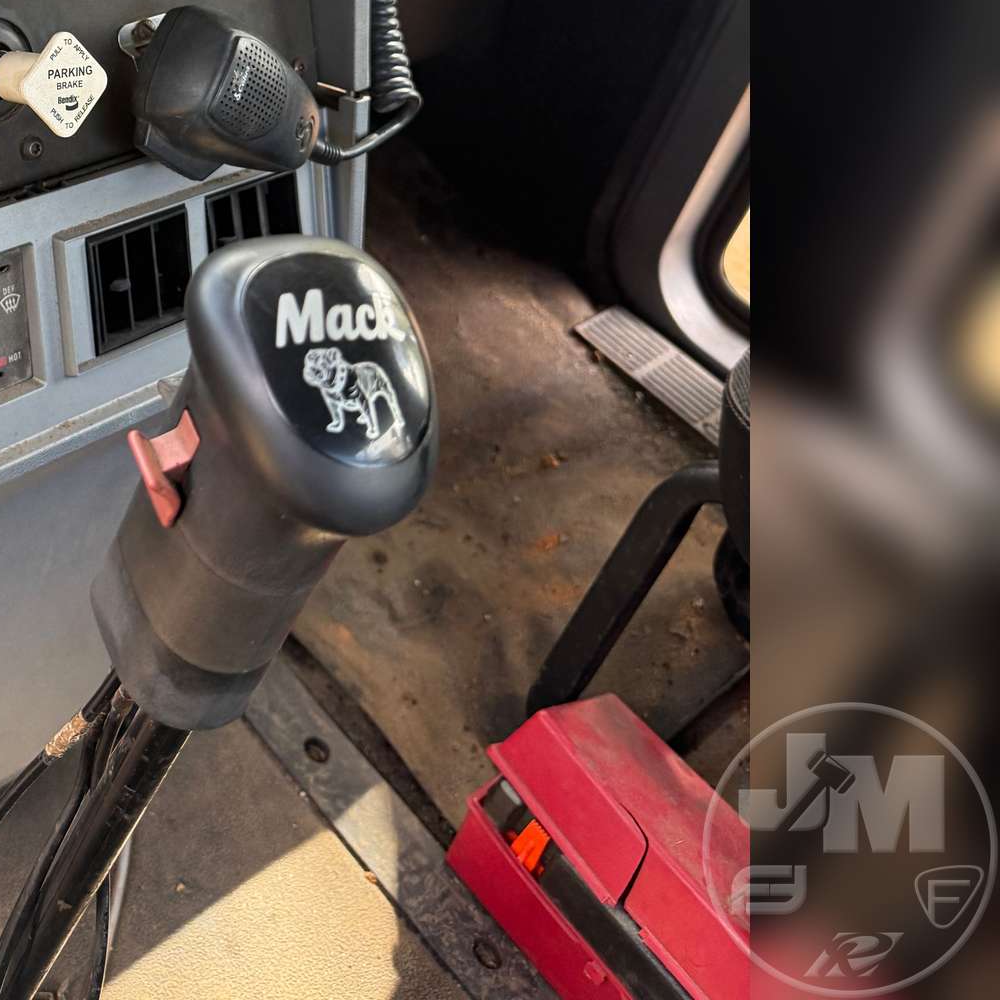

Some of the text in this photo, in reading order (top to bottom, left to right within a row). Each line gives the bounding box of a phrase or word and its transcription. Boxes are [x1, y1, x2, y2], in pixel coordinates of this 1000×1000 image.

[50, 46, 63, 61] PULL
[64, 38, 73, 46] TO
[47, 65, 93, 79] PARKING
[56, 80, 84, 91] BRAKE
[51, 93, 95, 130] PUSH TO RELEASE
[275, 288, 406, 348] Mack
[8, 351, 22, 363] HOT
